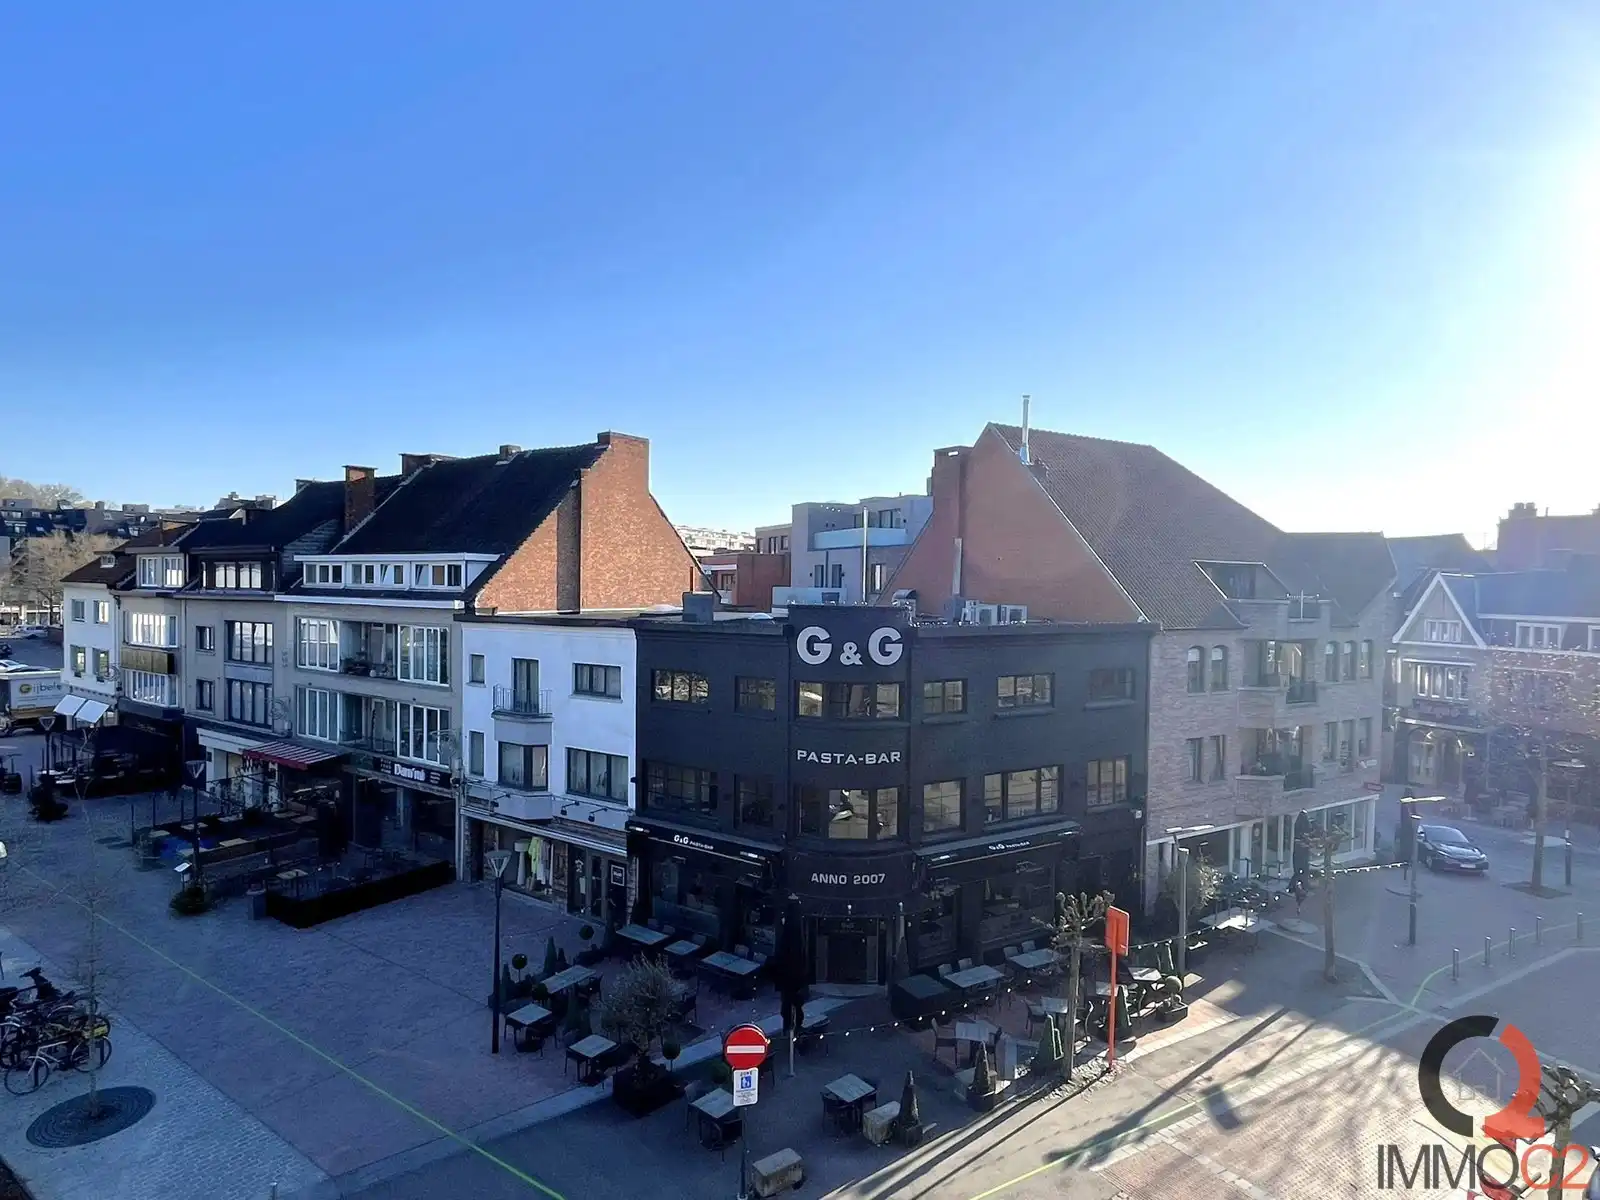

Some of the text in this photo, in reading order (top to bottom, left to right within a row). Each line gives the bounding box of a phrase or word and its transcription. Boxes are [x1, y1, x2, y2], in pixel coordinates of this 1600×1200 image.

[797, 749, 901, 765] PASTA-BAR
[811, 872, 886, 885] ANNO 2007
